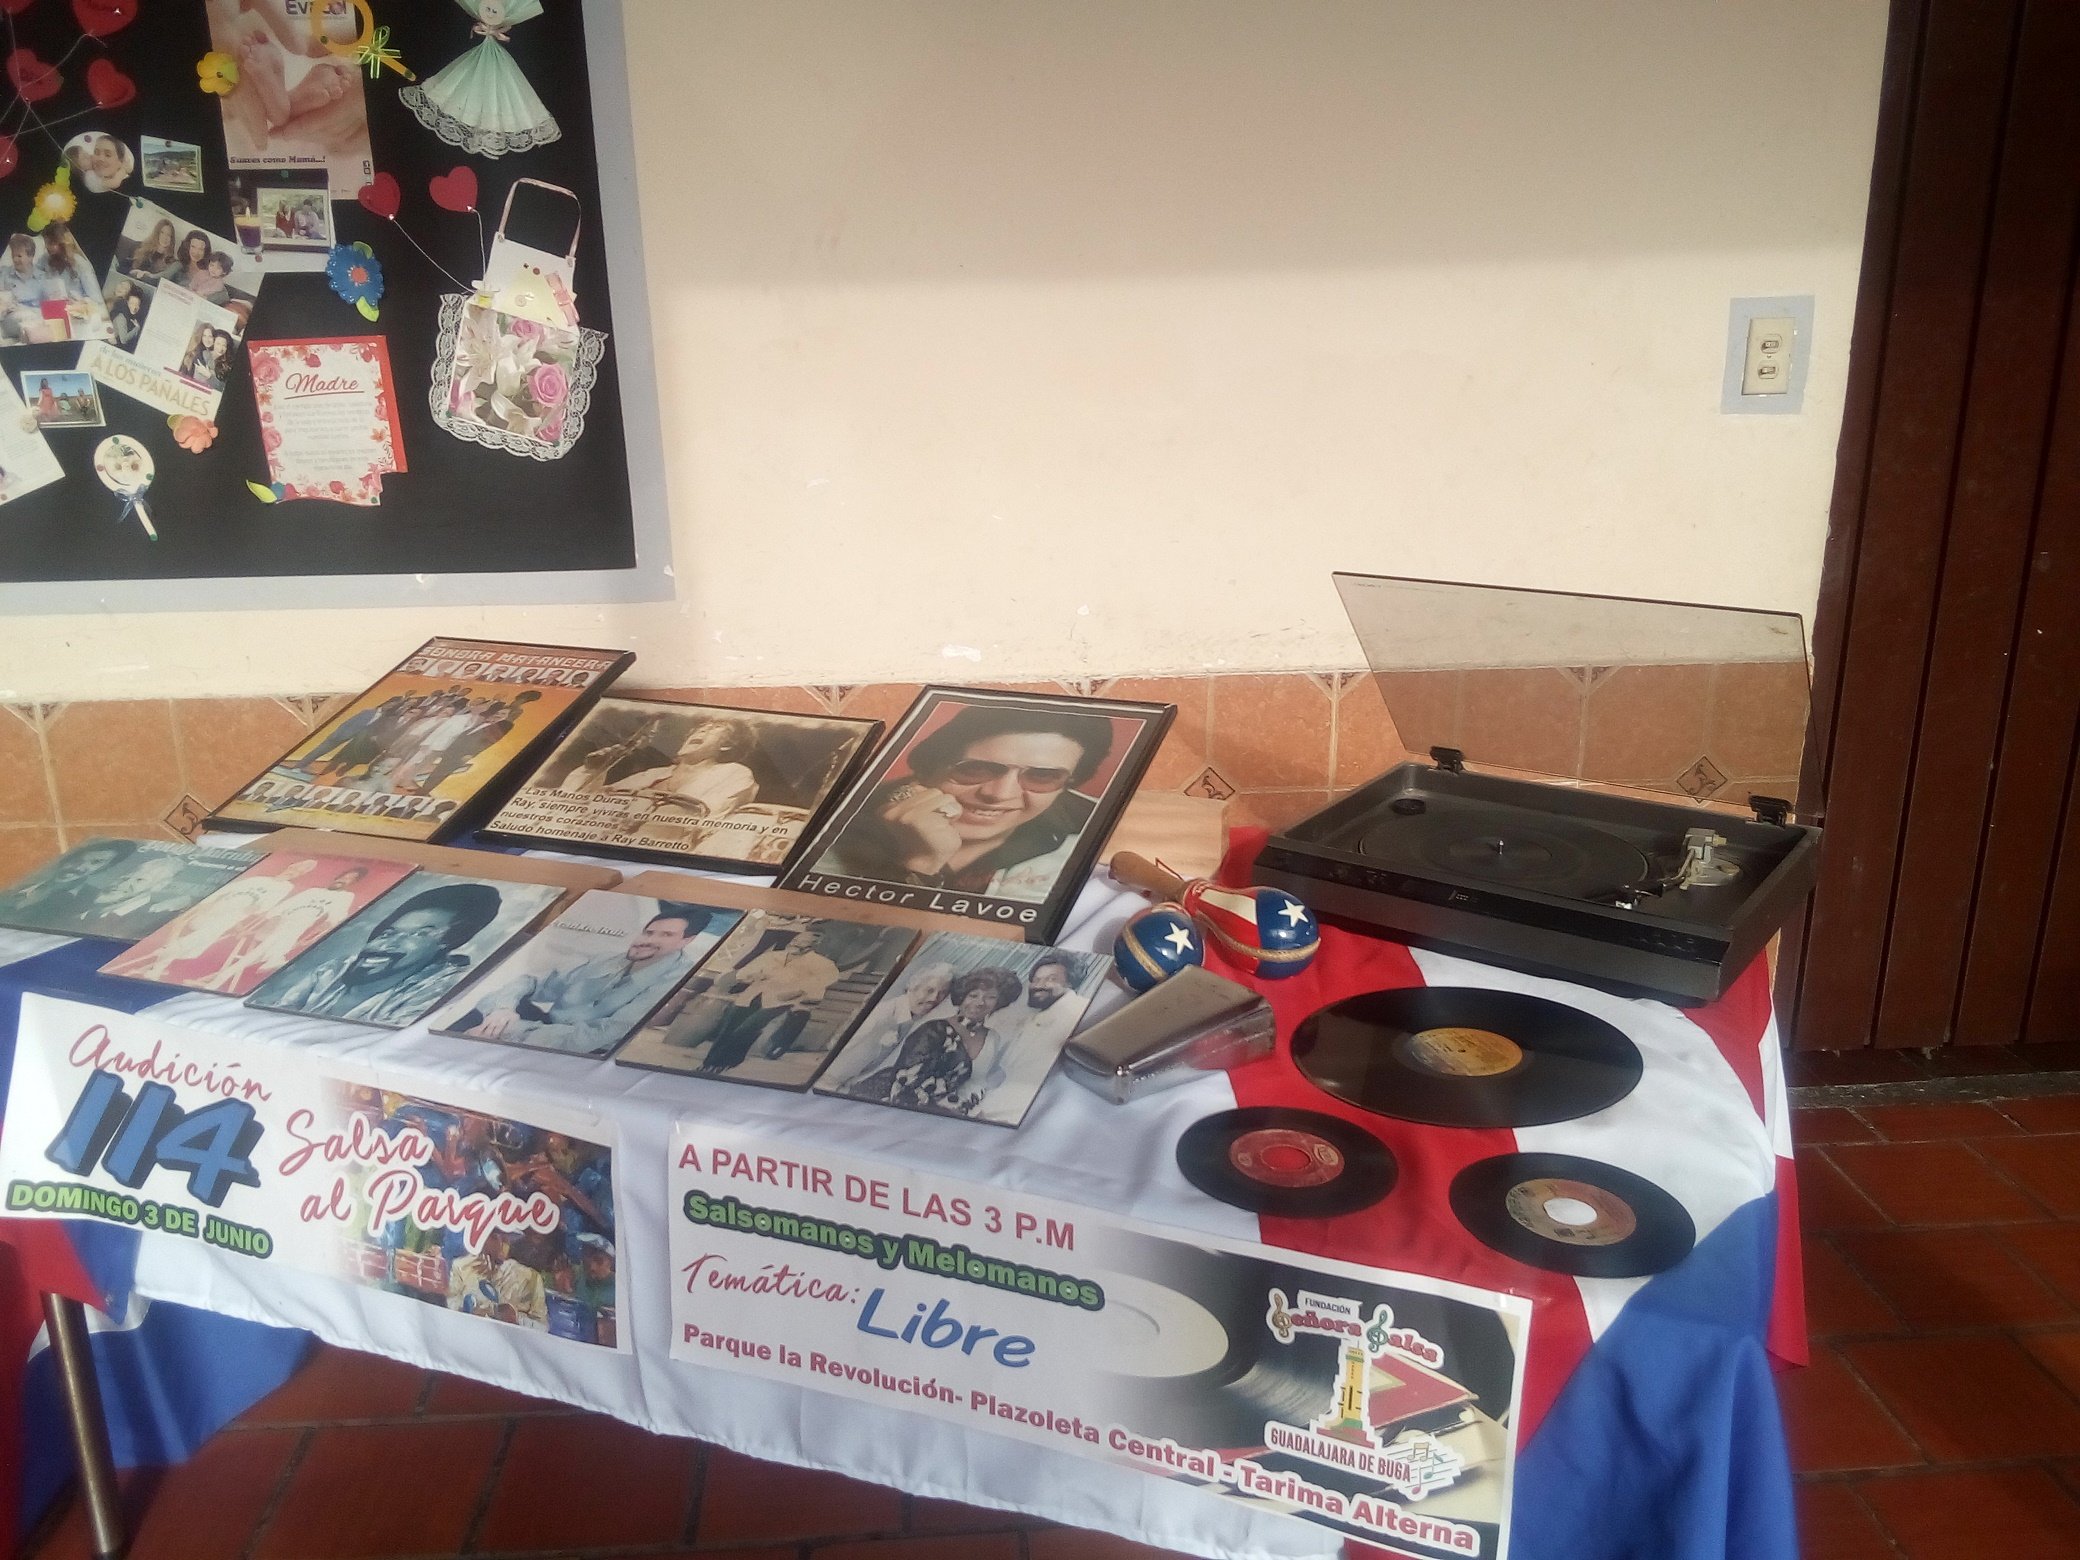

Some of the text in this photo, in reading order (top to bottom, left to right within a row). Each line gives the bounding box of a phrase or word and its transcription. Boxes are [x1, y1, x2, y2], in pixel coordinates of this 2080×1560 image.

[89, 357, 103, 375] A
[105, 359, 137, 386] LOS
[138, 371, 212, 417] PAÑALES
[284, 372, 359, 394] Madre
[417, 645, 613, 672] SONORA MATANCERA
[500, 811, 553, 822] nuestros
[538, 800, 589, 814] siempre
[633, 812, 649, 822] en
[652, 814, 699, 826] nuestra
[701, 819, 758, 831] memoria
[757, 824, 769, 835] y
[771, 827, 788, 835] en
[549, 790, 590, 801] Manos
[489, 820, 533, 833] Saludo
[535, 827, 598, 841] homenaje
[612, 834, 637, 846] Ray
[638, 837, 690, 850] Barretto
[796, 873, 1040, 924] Hector Lavoe
[67, 1024, 275, 1103] Audición
[46, 1069, 264, 1208] 114
[278, 1108, 430, 1178] Salsa
[9, 1183, 271, 1255] DOMINGO 3 DE JUNIO
[299, 1169, 557, 1251] al Parque
[678, 1143, 1076, 1252] A PARTIR DE LAS 3 P.M
[687, 1194, 1100, 1308] Salsomanos y Melomanos
[681, 1252, 1037, 1369] Temática: Libre
[1304, 1297, 1351, 1316] FUNDACIÓN
[683, 1322, 772, 1363] Parque
[779, 1343, 802, 1369] la
[970, 1389, 1100, 1445] Plazoleta
[1108, 1427, 1215, 1478] Central
[1240, 1464, 1344, 1516] Tarima
[1352, 1499, 1474, 1552] Alterna
[1270, 1426, 1412, 1484] GUADALAJARA DE BUGA
